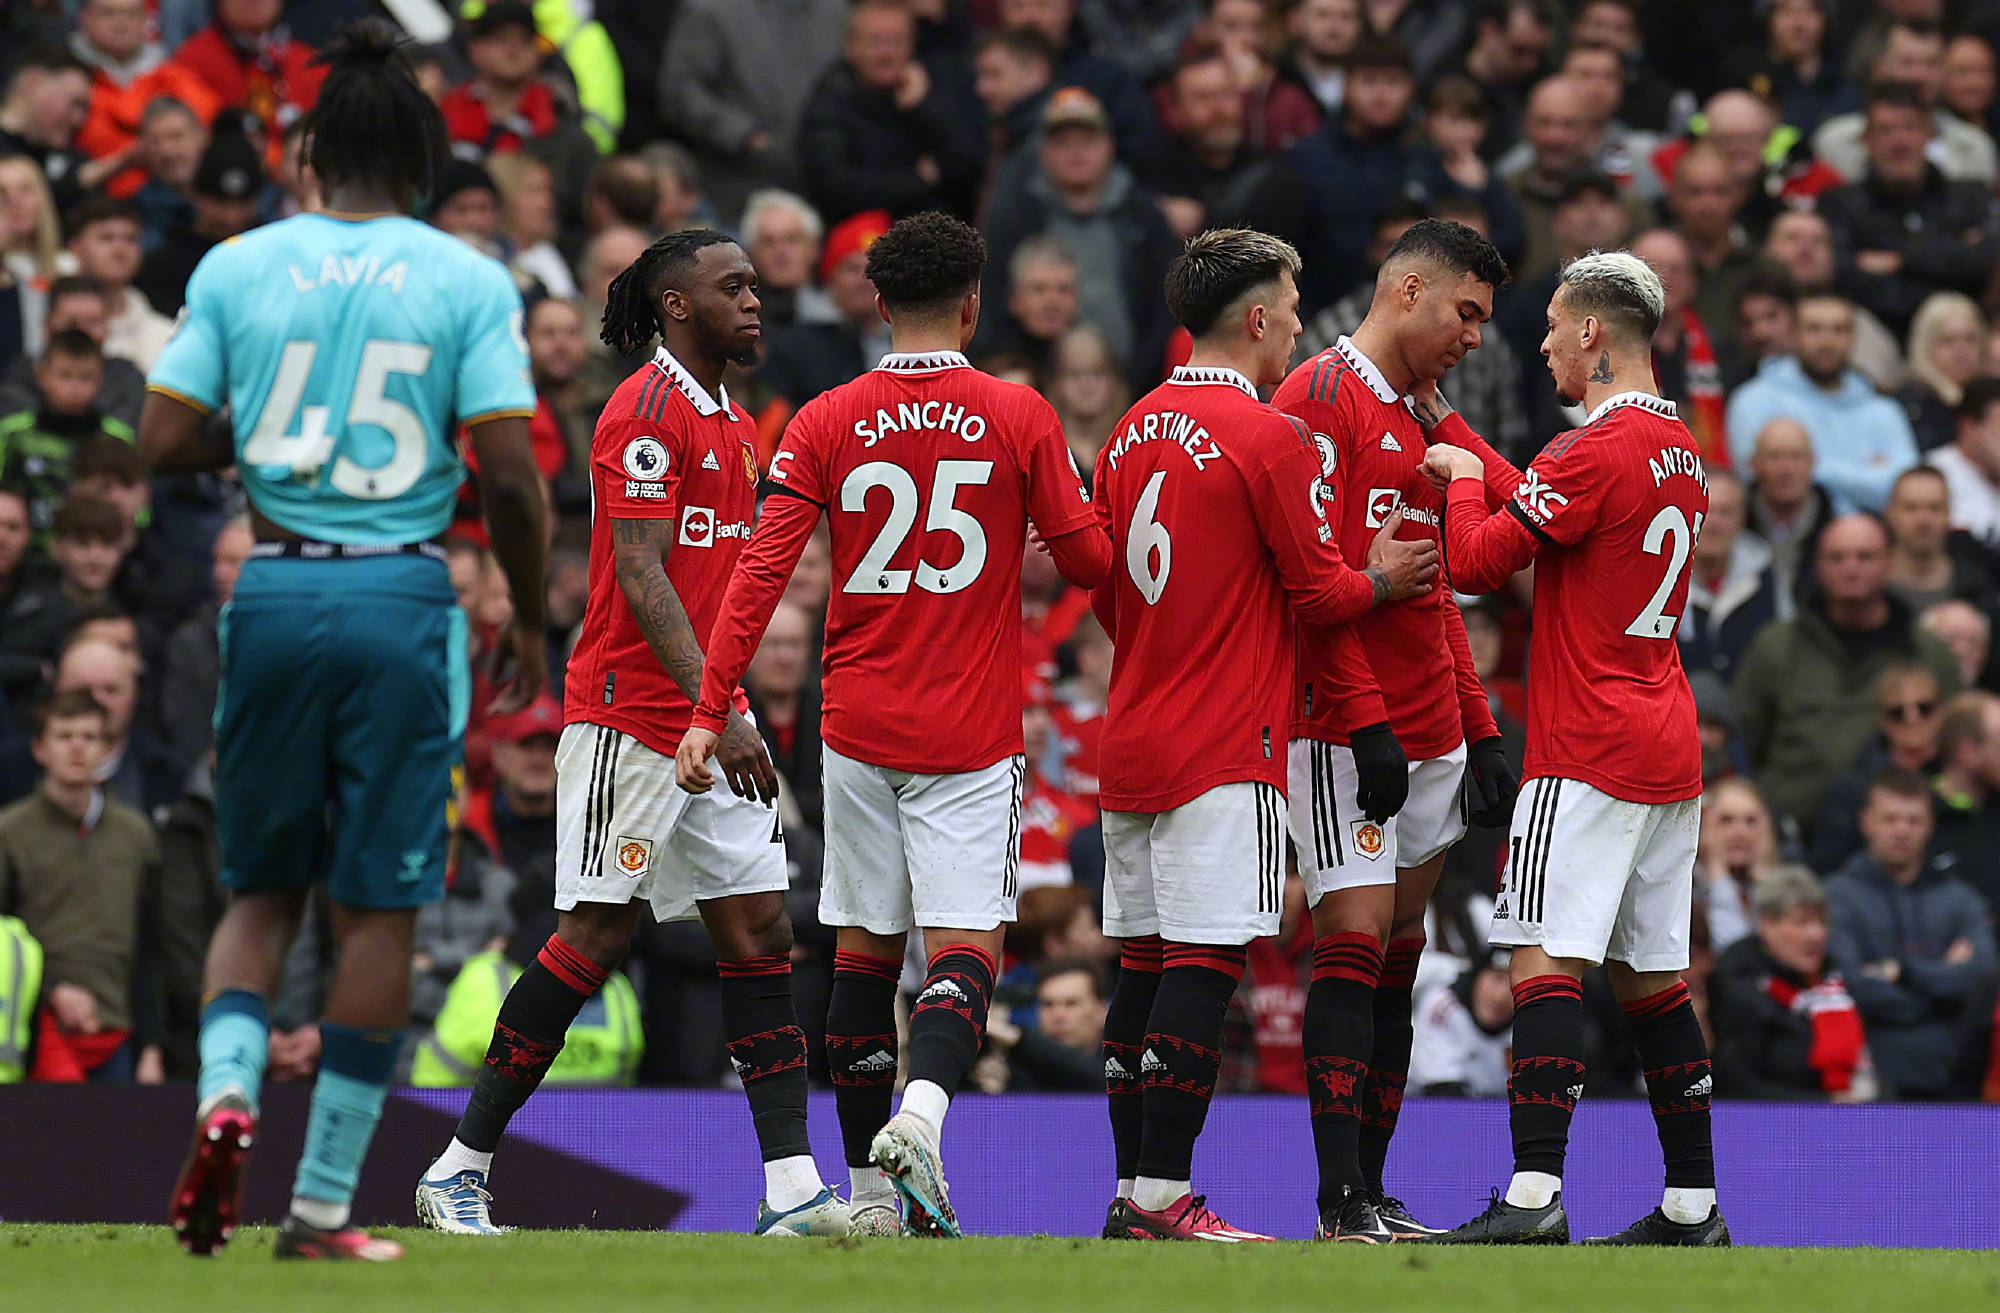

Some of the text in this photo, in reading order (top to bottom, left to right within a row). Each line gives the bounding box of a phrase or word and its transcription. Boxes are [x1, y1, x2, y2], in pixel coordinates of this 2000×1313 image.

[287, 253, 408, 296] LAVIA
[243, 340, 433, 501] 45
[854, 400, 987, 448] SANCHO
[1108, 411, 1222, 471] MARTINEZ
[626, 480, 664, 491] No room
[840, 460, 994, 594] 25
[1126, 470, 1172, 606] 6
[1624, 505, 1704, 640] 2
